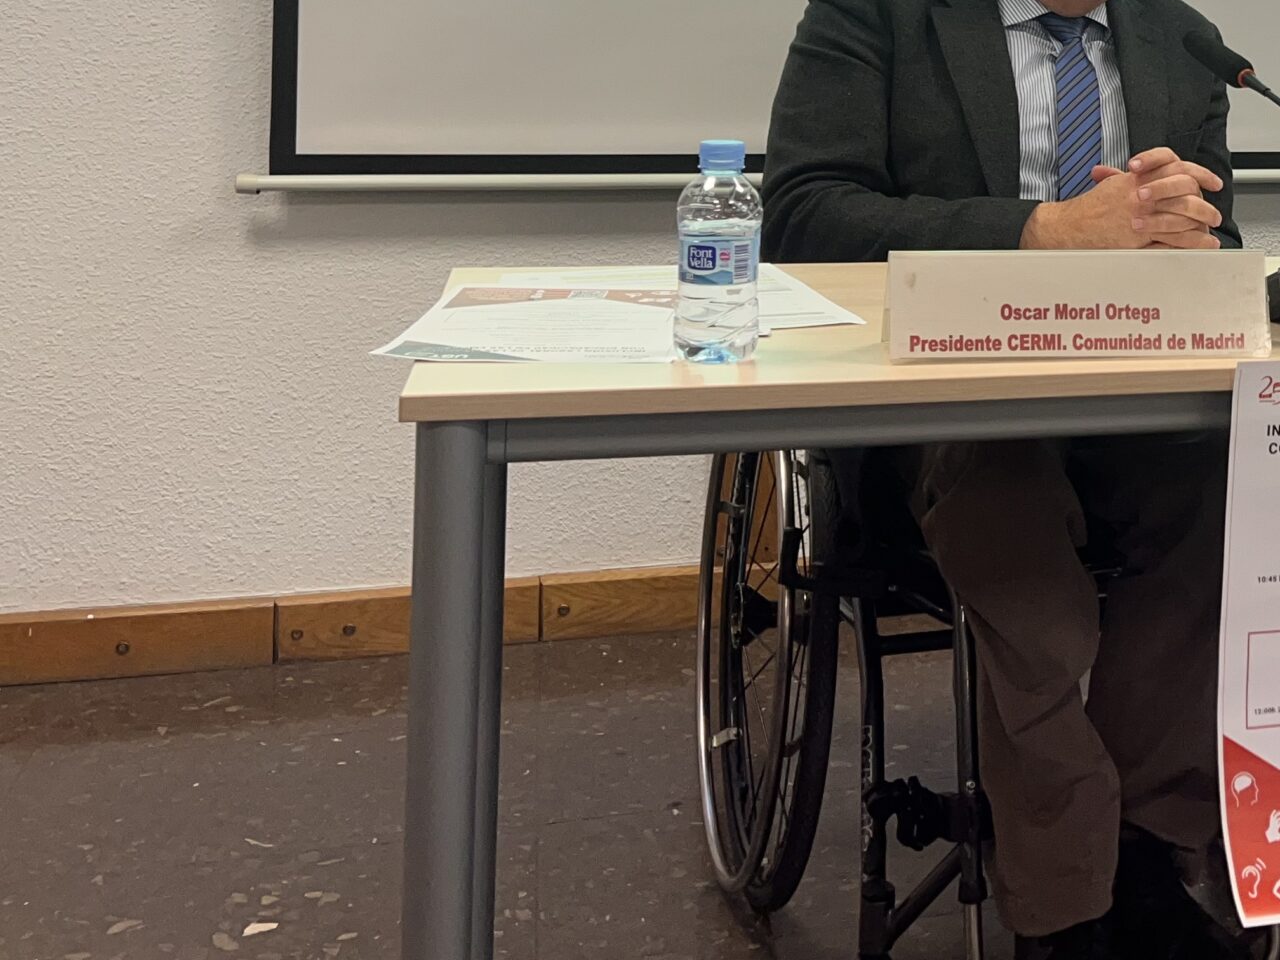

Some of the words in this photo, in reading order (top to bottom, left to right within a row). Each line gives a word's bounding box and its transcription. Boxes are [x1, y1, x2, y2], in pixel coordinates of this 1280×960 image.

[689, 246, 714, 259] Font
[689, 256, 713, 269] Vella
[1000, 304, 1050, 321] Oscar
[1054, 304, 1100, 320] Moral
[1105, 304, 1160, 324] Ortega
[909, 335, 1002, 352] Presidente
[1007, 334, 1067, 351] CERMI.
[1072, 333, 1162, 350] Comunidad
[1167, 333, 1187, 350] de
[1191, 333, 1245, 350] Madrid
